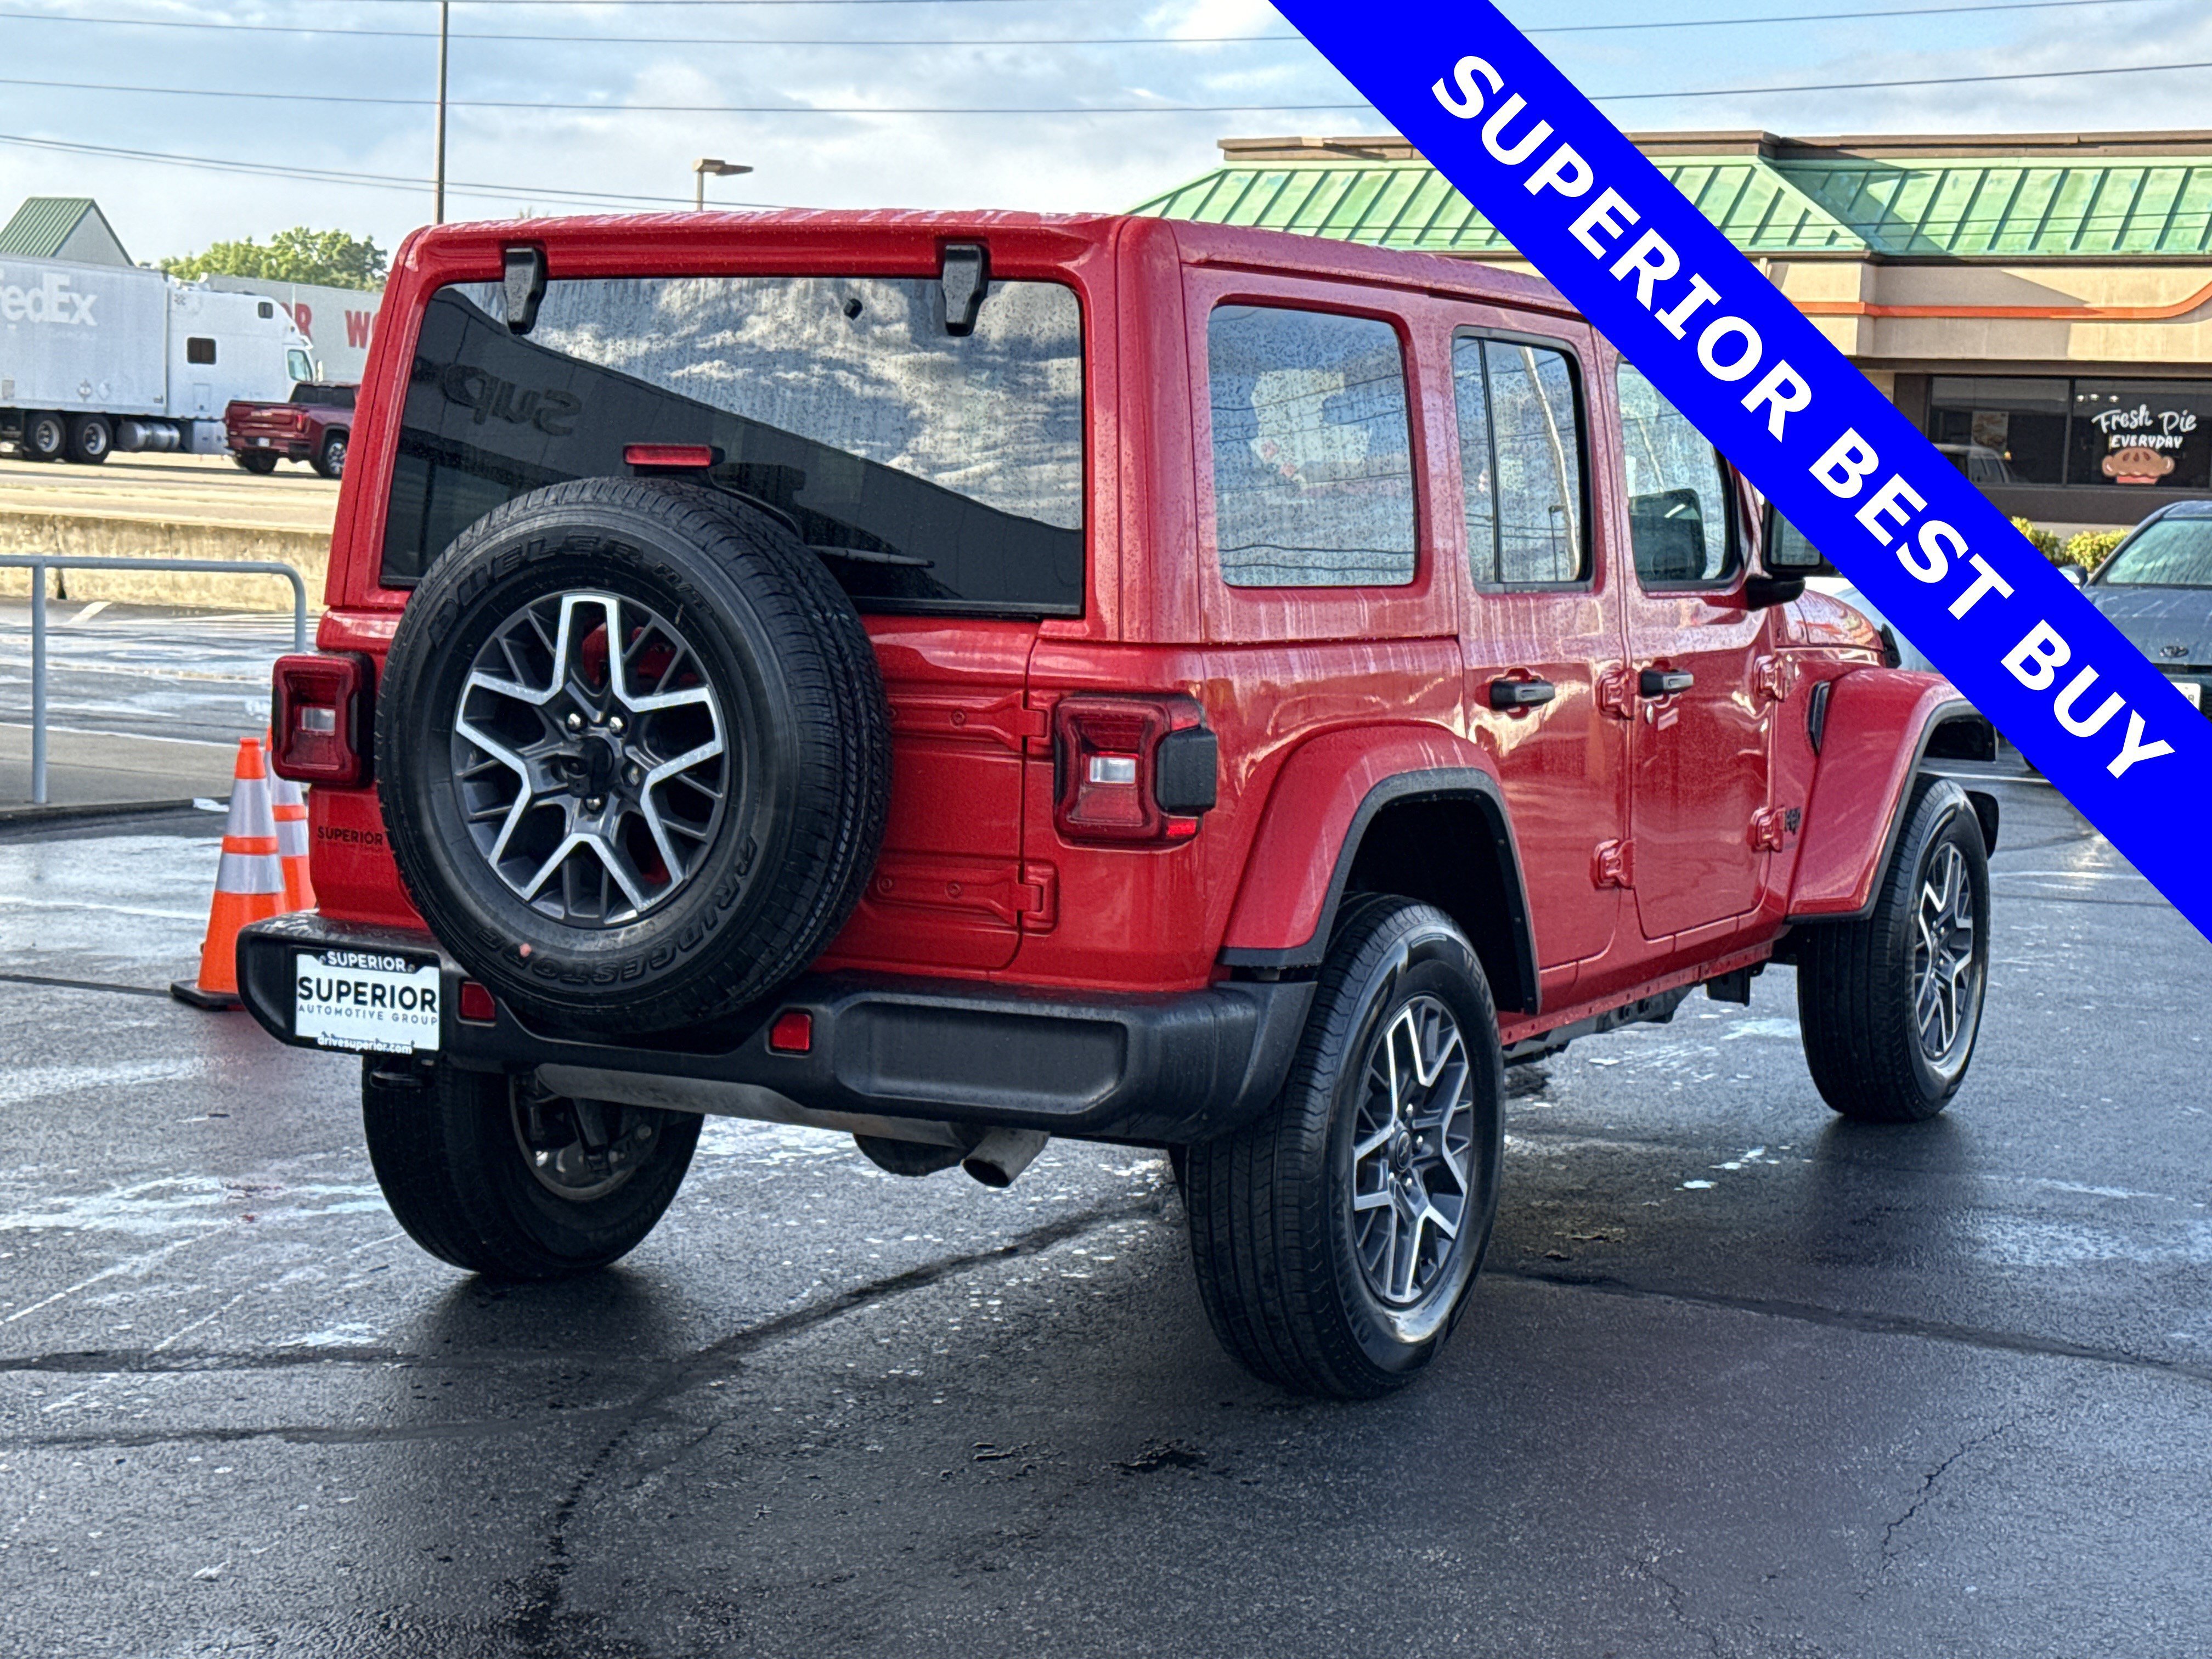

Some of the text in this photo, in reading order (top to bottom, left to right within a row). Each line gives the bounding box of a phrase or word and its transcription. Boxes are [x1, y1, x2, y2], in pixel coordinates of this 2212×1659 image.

[0, 269, 98, 326] edEx
[345, 309, 382, 349] W
[2091, 404, 2197, 436] Fresh Pie
[428, 531, 644, 647] DUELER
[317, 826, 383, 845] SUPERIOR
[475, 834, 758, 986] BRIDGESTONE
[327, 951, 406, 972] SUPERIOR
[298, 977, 437, 1013] SUPERIOR
[298, 1004, 438, 1026] AUTOMOTIVE GROUP
[317, 1032, 413, 1055] drivesuperior.com
